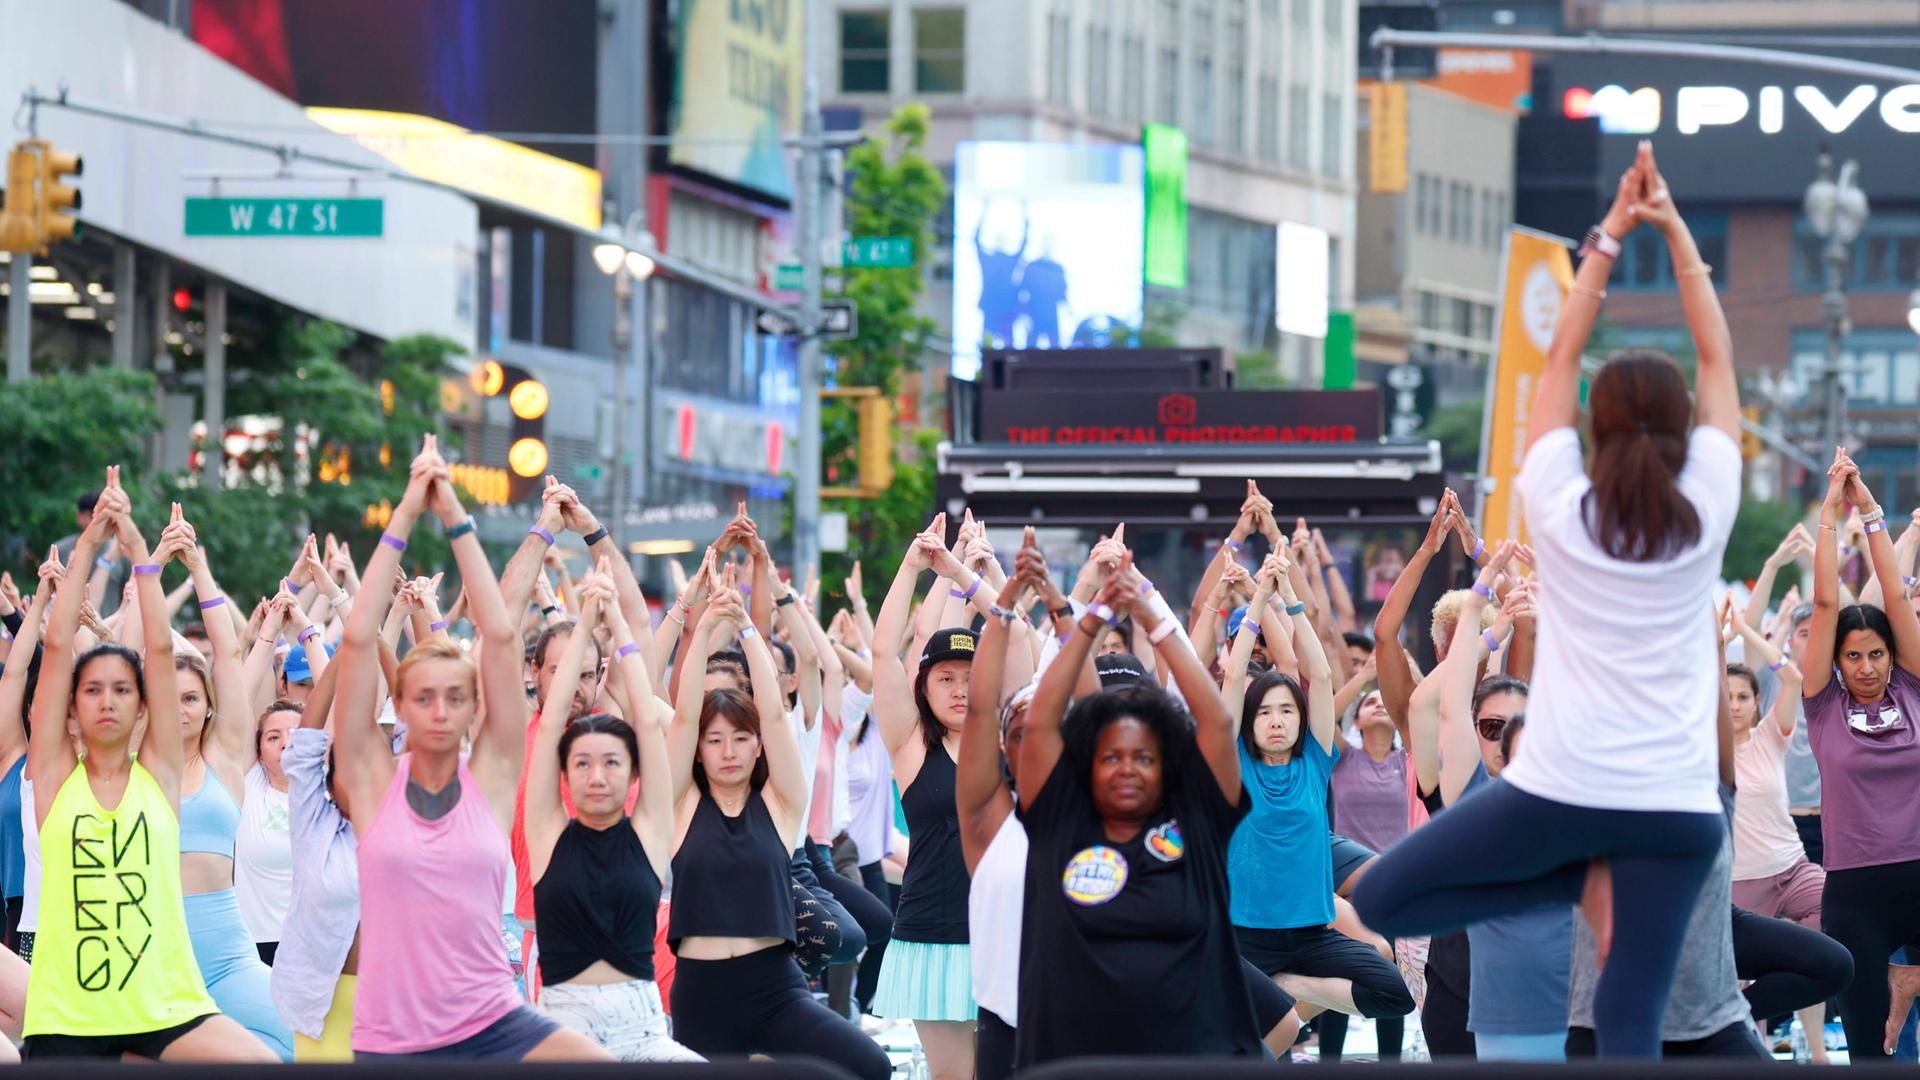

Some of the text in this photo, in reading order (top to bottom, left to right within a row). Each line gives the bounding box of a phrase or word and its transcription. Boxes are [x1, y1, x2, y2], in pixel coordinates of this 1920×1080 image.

[229, 203, 338, 232] W 47 St
[1007, 425, 1356, 444] THE OFFICIAL PHOTOGRAPHER
